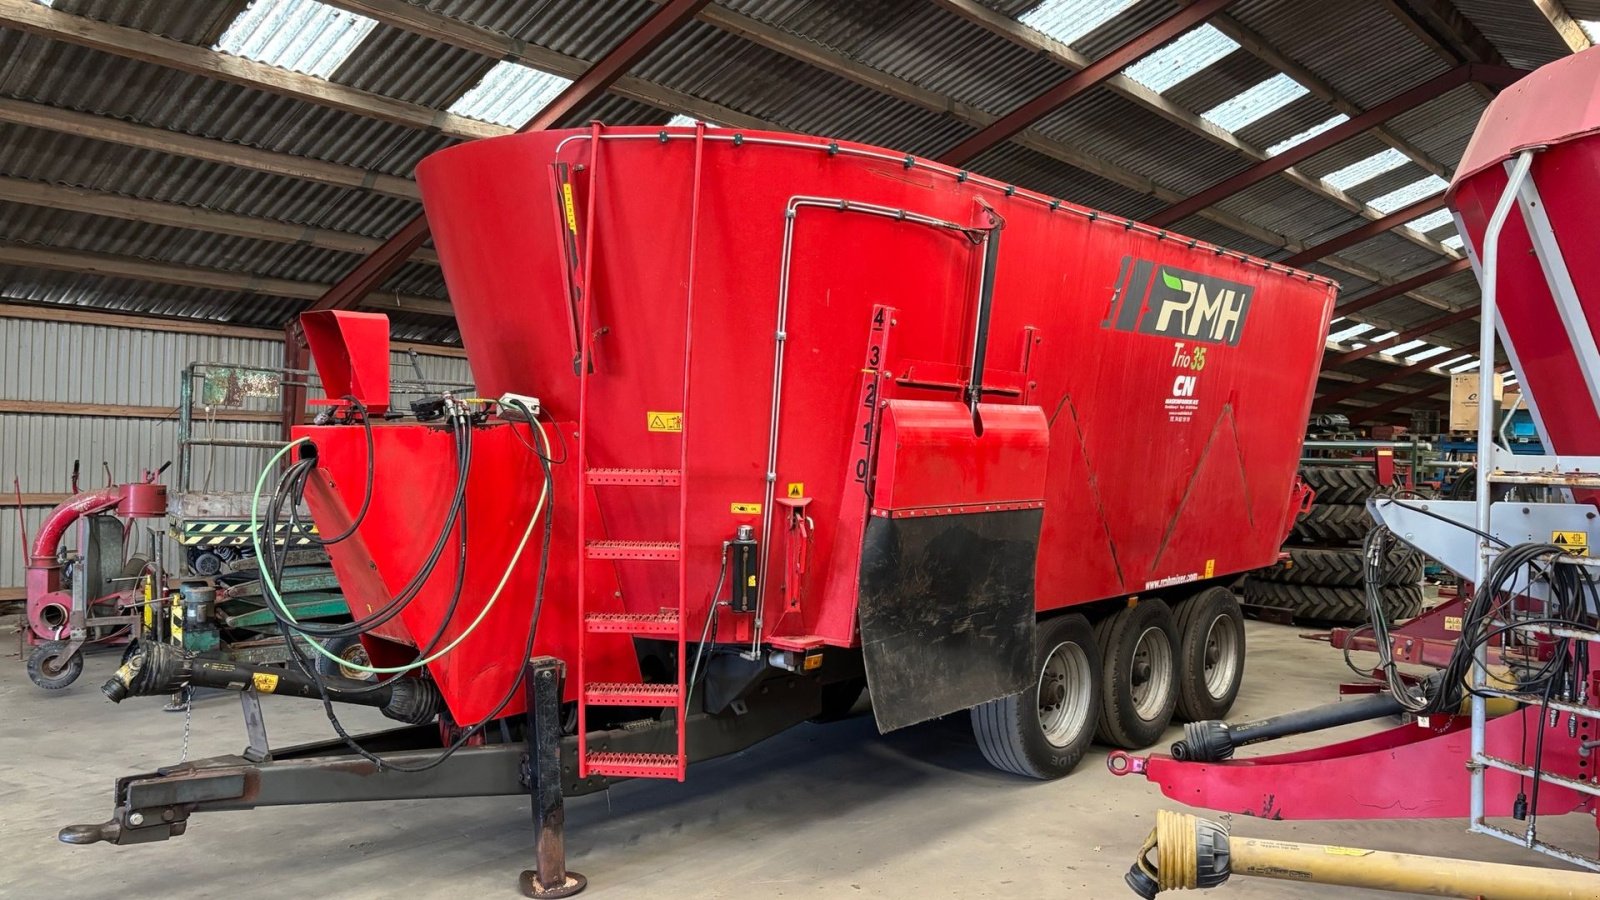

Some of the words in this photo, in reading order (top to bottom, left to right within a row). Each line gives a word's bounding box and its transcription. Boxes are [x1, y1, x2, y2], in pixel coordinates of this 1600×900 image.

[874, 307, 884, 328] 4
[1155, 275, 1246, 342] RMH
[870, 345, 880, 366] 3
[1171, 342, 1191, 368] Trio
[1190, 346, 1208, 371] 35
[865, 384, 875, 404] 2
[1172, 375, 1197, 397] CN
[863, 423, 872, 442] 1
[856, 459, 867, 479] 0
